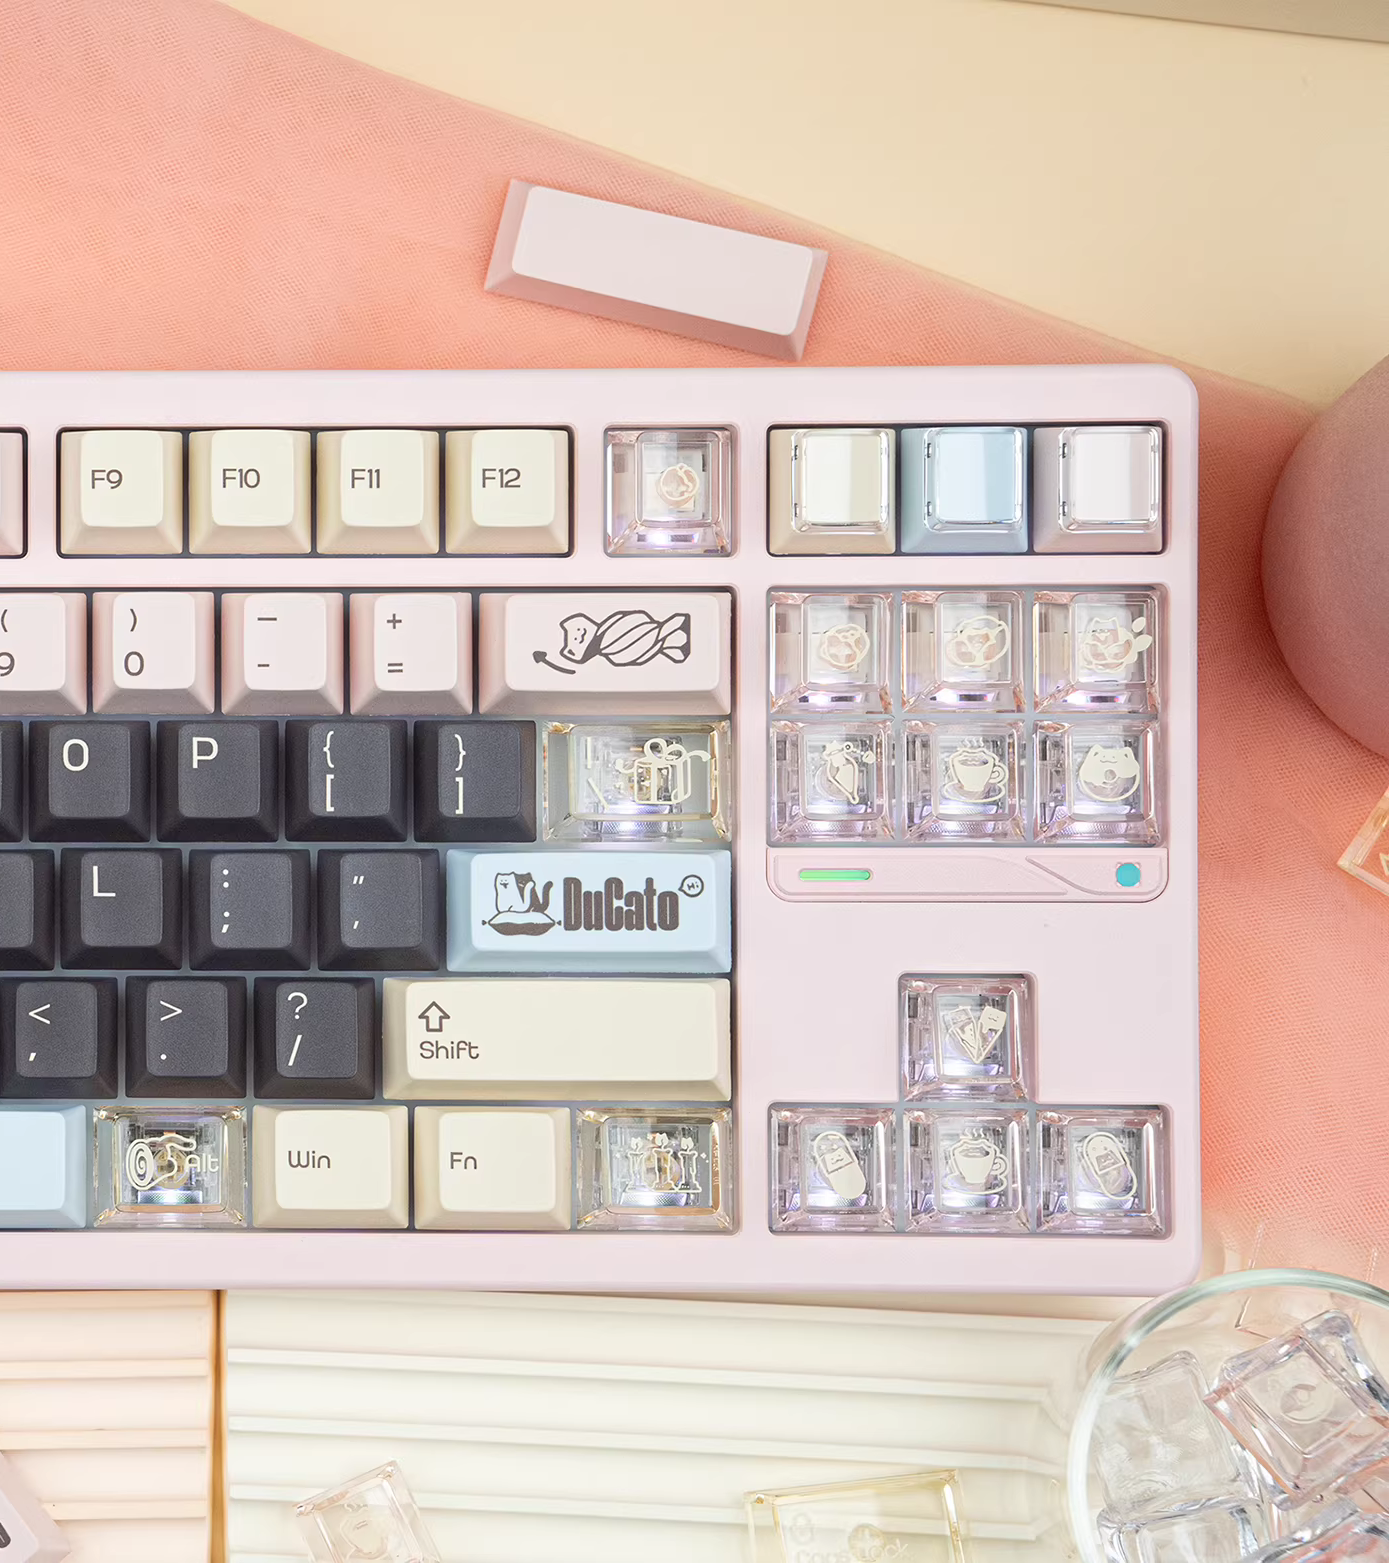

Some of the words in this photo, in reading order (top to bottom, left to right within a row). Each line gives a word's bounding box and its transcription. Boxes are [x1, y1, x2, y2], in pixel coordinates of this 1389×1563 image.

[91, 469, 123, 490] F9
[222, 468, 261, 489] F10
[351, 468, 381, 489] F11
[482, 468, 521, 489] F12
[0, 608, 8, 633] (
[129, 608, 138, 632] )
[386, 613, 403, 630] +
[123, 651, 145, 677] 0
[387, 662, 404, 674] =
[62, 738, 89, 772] O
[192, 736, 219, 769] P
[322, 730, 335, 769] {
[454, 733, 467, 772] }
[325, 773, 335, 812] [
[455, 776, 464, 815] ]
[92, 865, 116, 897] L
[222, 868, 230, 889] :
[563, 877, 680, 931] DuCato
[221, 911, 230, 934] ;
[28, 1003, 51, 1025] <
[159, 1000, 183, 1022] >
[287, 991, 308, 1020] ?
[287, 1034, 303, 1067] /
[419, 1040, 480, 1060] Shift
[185, 1154, 219, 1173] Alt
[288, 1150, 331, 1169] Win
[450, 1151, 478, 1170] Fn
